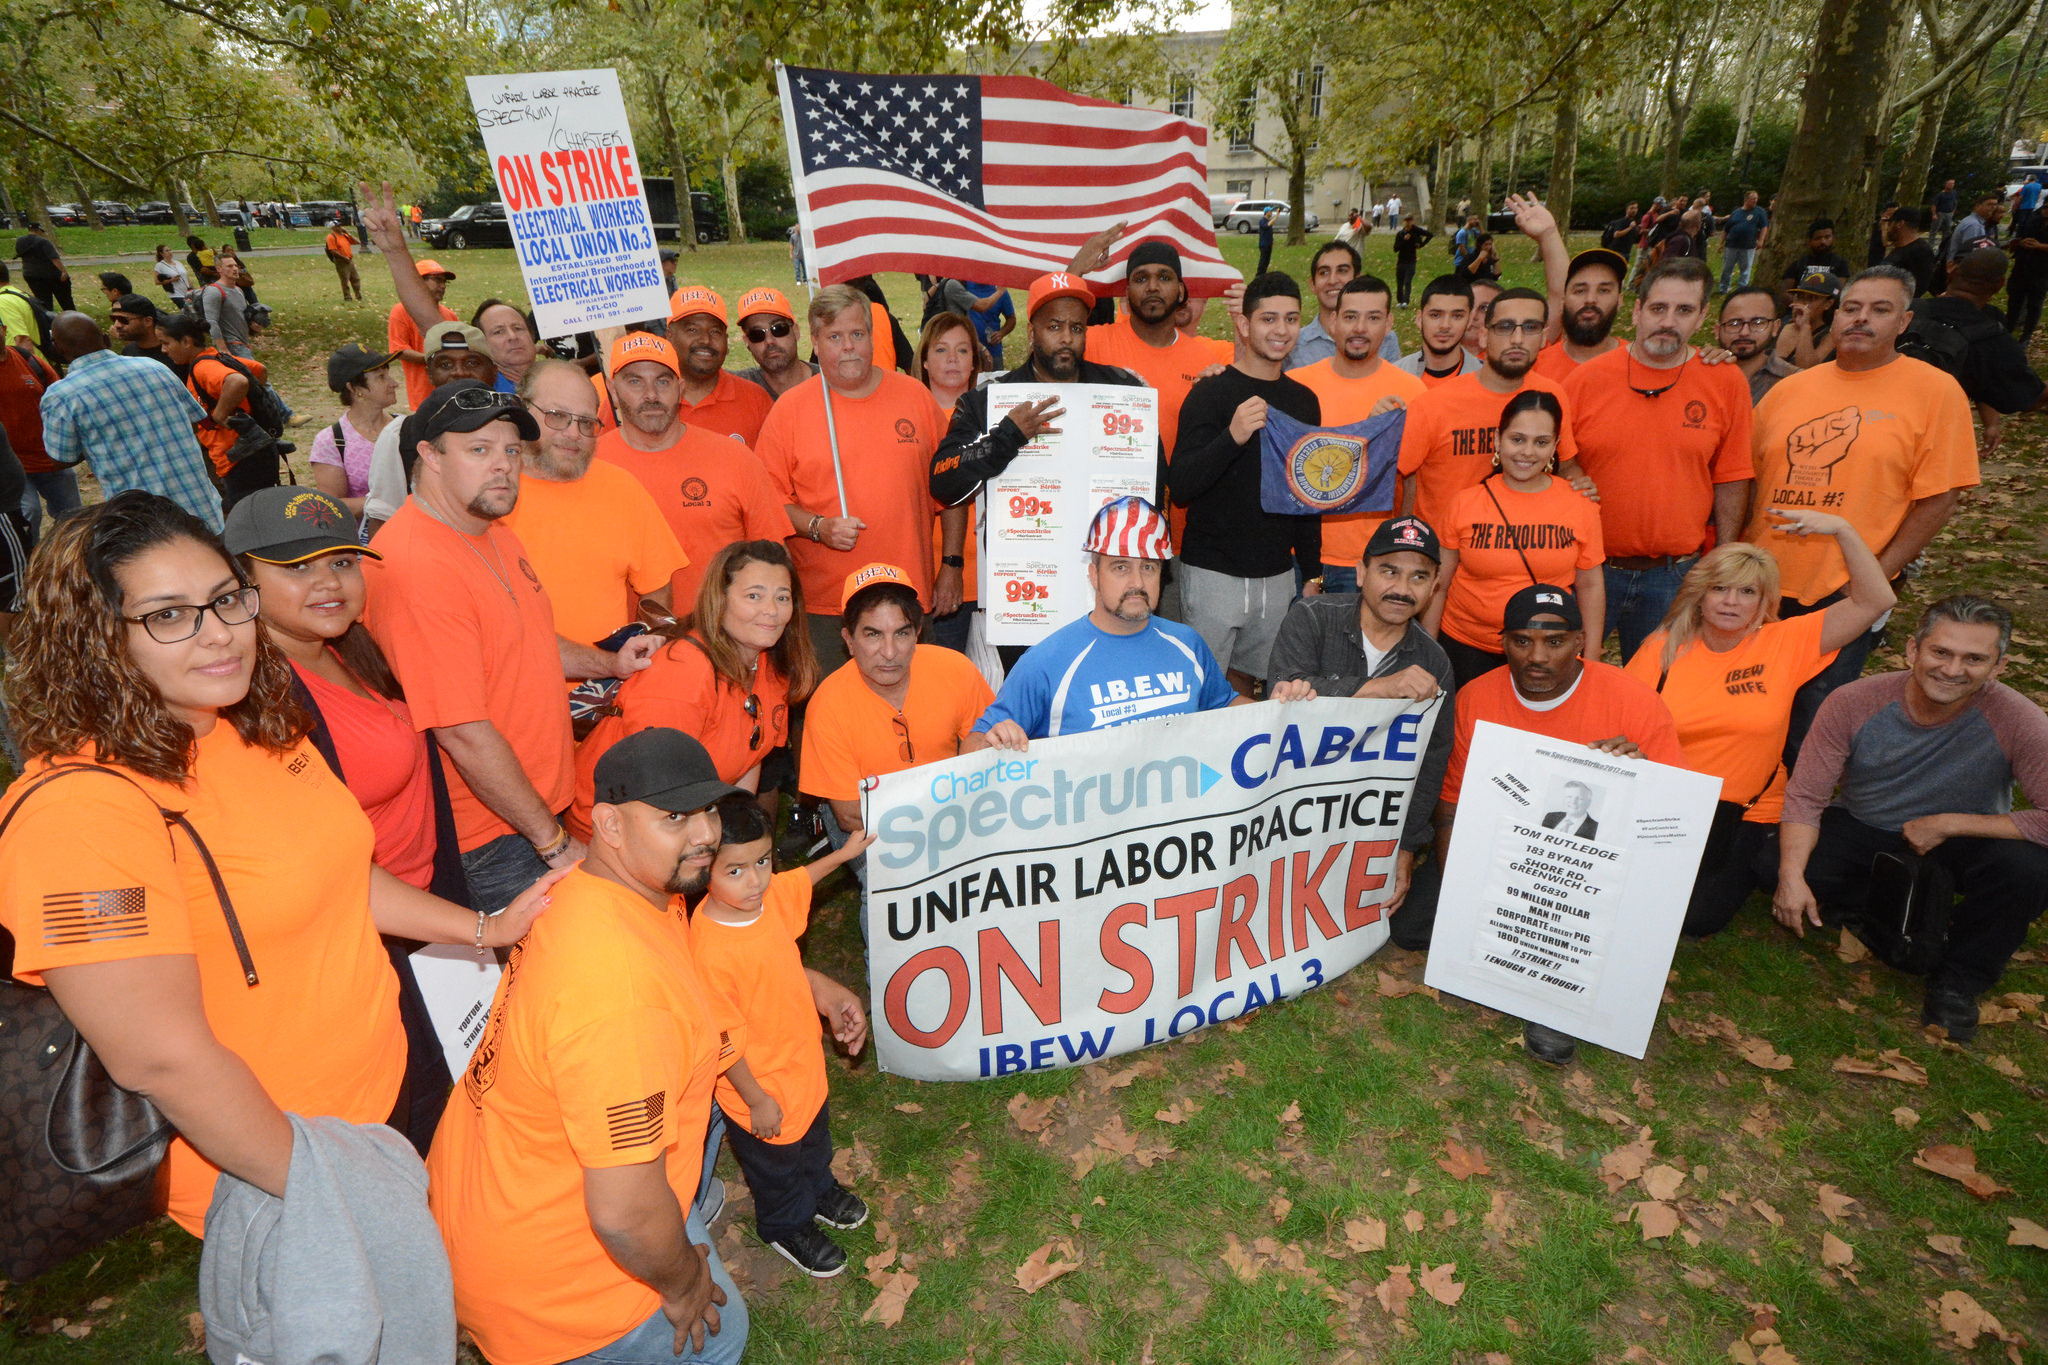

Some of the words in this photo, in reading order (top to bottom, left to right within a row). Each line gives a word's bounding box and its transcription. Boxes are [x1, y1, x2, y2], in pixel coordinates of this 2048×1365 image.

[492, 92, 528, 105] UNFAIR
[533, 88, 559, 99] LABOR
[563, 85, 601, 98] PRACTICE
[554, 128, 624, 151] CHARTER
[498, 155, 543, 212] ON
[540, 145, 639, 207] STRIKE
[512, 206, 586, 240] ELECTRICAL
[587, 198, 645, 230] WORKERS
[519, 235, 571, 266] LOCAL
[570, 229, 620, 260] UNION
[619, 225, 652, 252] No.3
[529, 268, 589, 286] International
[591, 260, 646, 277] Brotherhood
[647, 258, 656, 267] of
[551, 256, 611, 272] ESTABLISHED
[615, 254, 632, 262] 1891
[532, 277, 604, 305] ELECTRICAL
[603, 268, 660, 293] WORKERS
[682, 291, 717, 305] IBEW
[575, 295, 608, 305] AFFILIATED
[586, 301, 618, 312] AFL-CIO
[743, 291, 776, 309] IBEW
[563, 317, 582, 325] CALL
[586, 313, 605, 322] (718)
[608, 309, 620, 317] 591
[626, 305, 643, 313] 4000
[622, 337, 666, 354] IBEW
[1103, 413, 1144, 436] 99%
[1452, 428, 1475, 456] THE
[933, 455, 960, 475] Riding
[1009, 496, 1053, 518] 99%
[1772, 489, 1816, 506] LOCAL
[1822, 491, 1844, 507] #3
[1035, 517, 1047, 528] 1%
[1405, 529, 1415, 539] 3
[1470, 523, 1493, 549] THE
[1495, 524, 1576, 550] REVOLUTION
[856, 566, 899, 589] IBEW
[1006, 580, 1049, 602] 99%
[1031, 602, 1043, 612] 1%
[1725, 664, 1765, 684] IBEW
[1726, 681, 1767, 696] WIFE
[1101, 706, 1122, 718] Local
[1124, 704, 1137, 714] #3
[1535, 748, 1638, 779] www.SpectrumStrike2017.com
[877, 756, 1198, 872] Spectrum
[1231, 714, 1424, 789] CABLE
[931, 759, 1039, 804] Charter
[1491, 776, 1512, 793] STRIKE
[1510, 789, 1531, 807] TV2017
[1505, 772, 1531, 793] YOUTUBE
[1513, 825, 1542, 839] TOM
[1543, 834, 1619, 861] RUTLEDGE
[887, 862, 1060, 941] UNFAIR
[1075, 830, 1217, 899] LABOR
[1229, 789, 1404, 866] PRACTICE
[1524, 857, 1565, 875] SHORE
[1566, 870, 1587, 882] RD.
[1526, 845, 1545, 856] 183
[1547, 851, 1593, 870] BYRAM
[1509, 862, 1582, 890] GREENWICH
[1584, 885, 1602, 896] CT
[1533, 882, 1568, 899] 06830
[1506, 886, 1519, 897] 99
[1520, 890, 1554, 908] MILLON
[1555, 902, 1590, 920] DOLLAR
[1528, 905, 1549, 919] MAN
[1496, 907, 1549, 931] CORPORATE
[1549, 926, 1573, 938] GREEDY
[1573, 931, 1591, 943] PIG
[883, 919, 1062, 1049] ON
[1097, 838, 1399, 1014] STRIKE
[1489, 919, 1513, 932] ALLOWS
[1514, 925, 1570, 950] SPECTURUM
[1570, 945, 1578, 953] TO
[1579, 949, 1592, 957] PUT
[1497, 931, 1519, 944] 1800
[1519, 940, 1539, 951] UNION
[1539, 947, 1570, 961] MEMBERS
[1570, 957, 1580, 965] ON
[1519, 951, 1554, 968] STRIKE
[1489, 955, 1526, 974] ENOUGH
[1527, 969, 1540, 978] IS
[1540, 973, 1580, 992] ENOUGH
[458, 1000, 483, 1032] YOUTUBE
[979, 1026, 1116, 1077] IBEW
[1144, 973, 1288, 1046] LOCAL
[1301, 958, 1324, 993] 3
[463, 1022, 483, 1048] STRIKE
